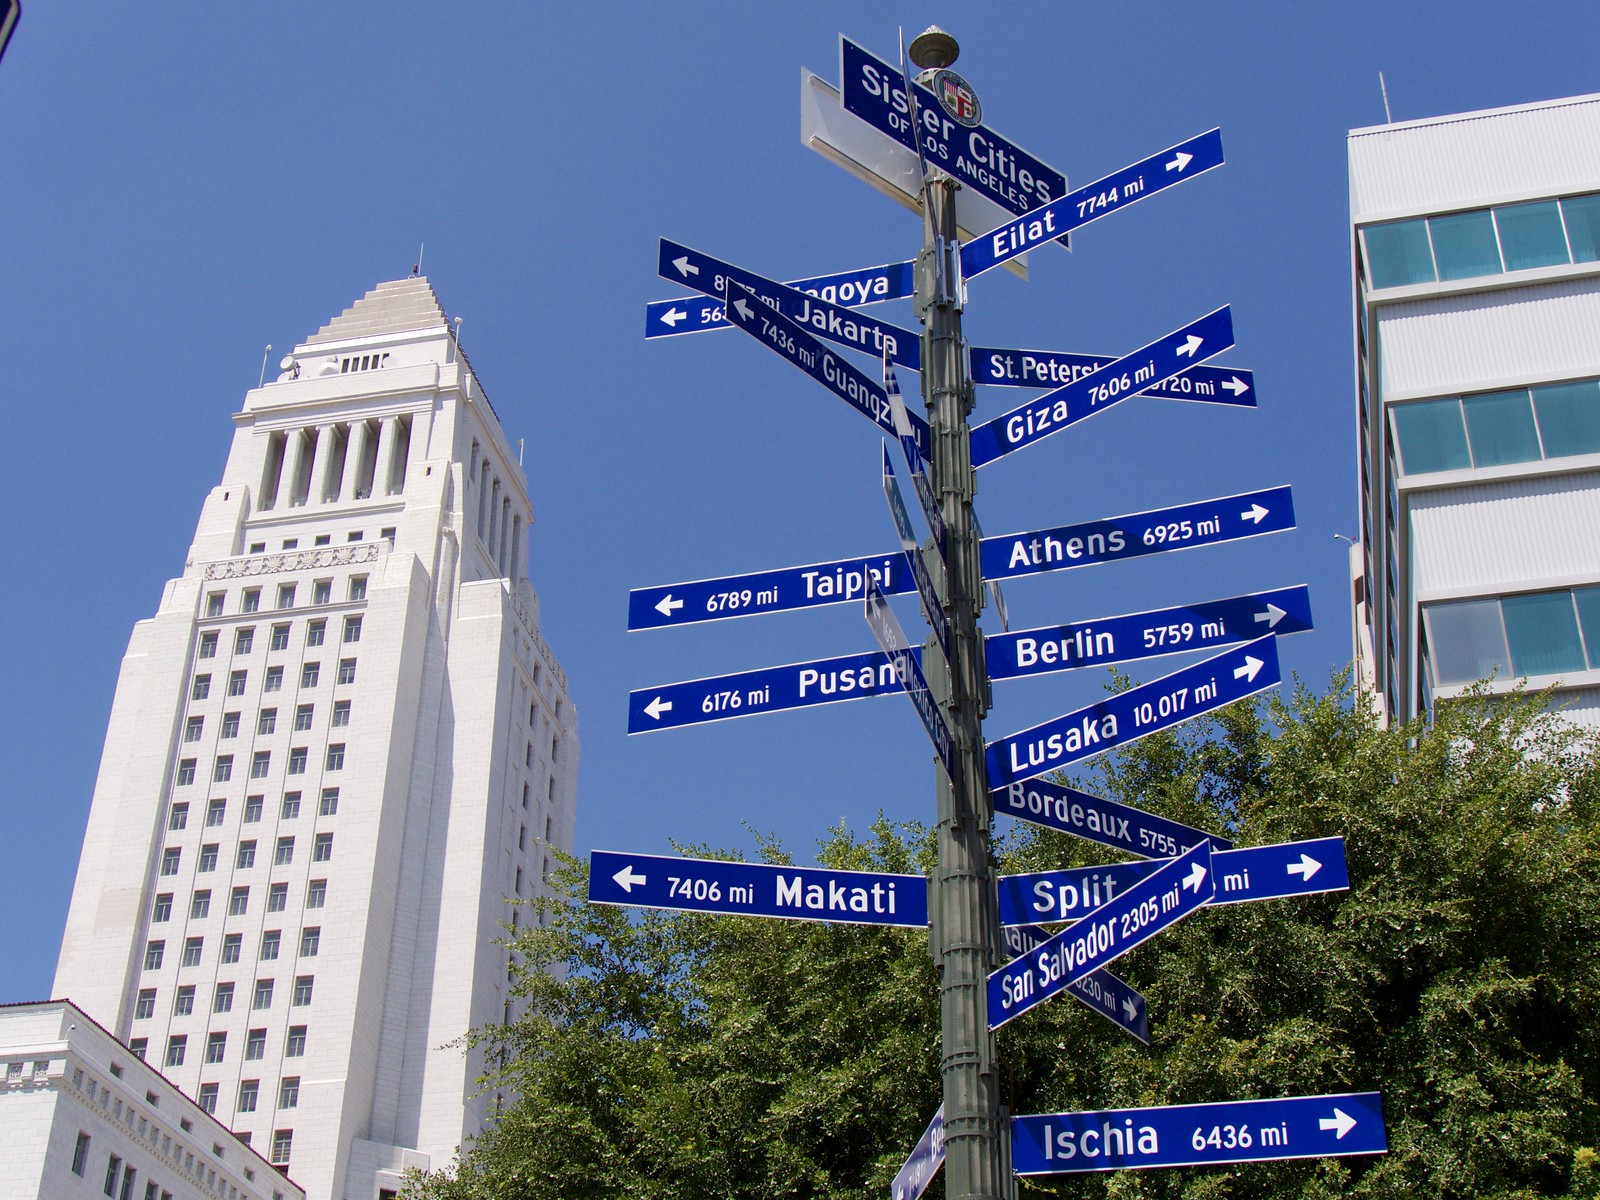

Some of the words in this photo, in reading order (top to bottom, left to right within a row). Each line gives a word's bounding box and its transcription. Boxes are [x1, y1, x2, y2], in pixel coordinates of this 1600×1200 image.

[888, 112, 910, 133] OF
[922, 136, 948, 160] OS
[956, 155, 1028, 210] ANGELES
[968, 132, 1051, 203] Cities
[993, 210, 1055, 259] Eilat
[1077, 188, 1119, 218] 7744
[1124, 175, 1145, 198] mi
[761, 317, 796, 354] 7436
[799, 345, 815, 369] mi
[794, 299, 898, 356] Jakarta
[1007, 400, 1068, 443] Giza
[1088, 373, 1131, 405] 7606
[1135, 360, 1155, 384] mi
[1195, 380, 1215, 395] mi
[1009, 529, 1126, 568] Athens
[1143, 521, 1193, 545] 6925
[1198, 516, 1221, 536] mi
[706, 590, 751, 612] 6789
[757, 586, 778, 604] mi
[1017, 628, 1114, 667] Berlin
[1143, 622, 1194, 648] 5759
[1201, 618, 1225, 639] mi
[702, 690, 742, 713] 6176
[748, 685, 770, 705] mi
[906, 650, 935, 721] Mexico
[935, 712, 950, 770] City
[1010, 714, 1118, 773] Lusaka
[1195, 677, 1217, 702] mi
[1008, 783, 1131, 842] Bordeaux
[1139, 828, 1177, 856] 5755
[667, 877, 721, 901] 7406
[729, 884, 753, 903] mi
[776, 875, 895, 914] Makati
[1033, 873, 1117, 918] Split
[1224, 868, 1249, 891] mi
[1002, 969, 1034, 1009] San
[1038, 916, 1117, 988] Salvador
[1121, 896, 1158, 939] 2305
[1162, 882, 1179, 914] mi
[1104, 990, 1116, 1012] mi
[1045, 1119, 1158, 1160] Ischia
[1192, 1124, 1252, 1151] 6436
[1261, 1121, 1288, 1147] mi
